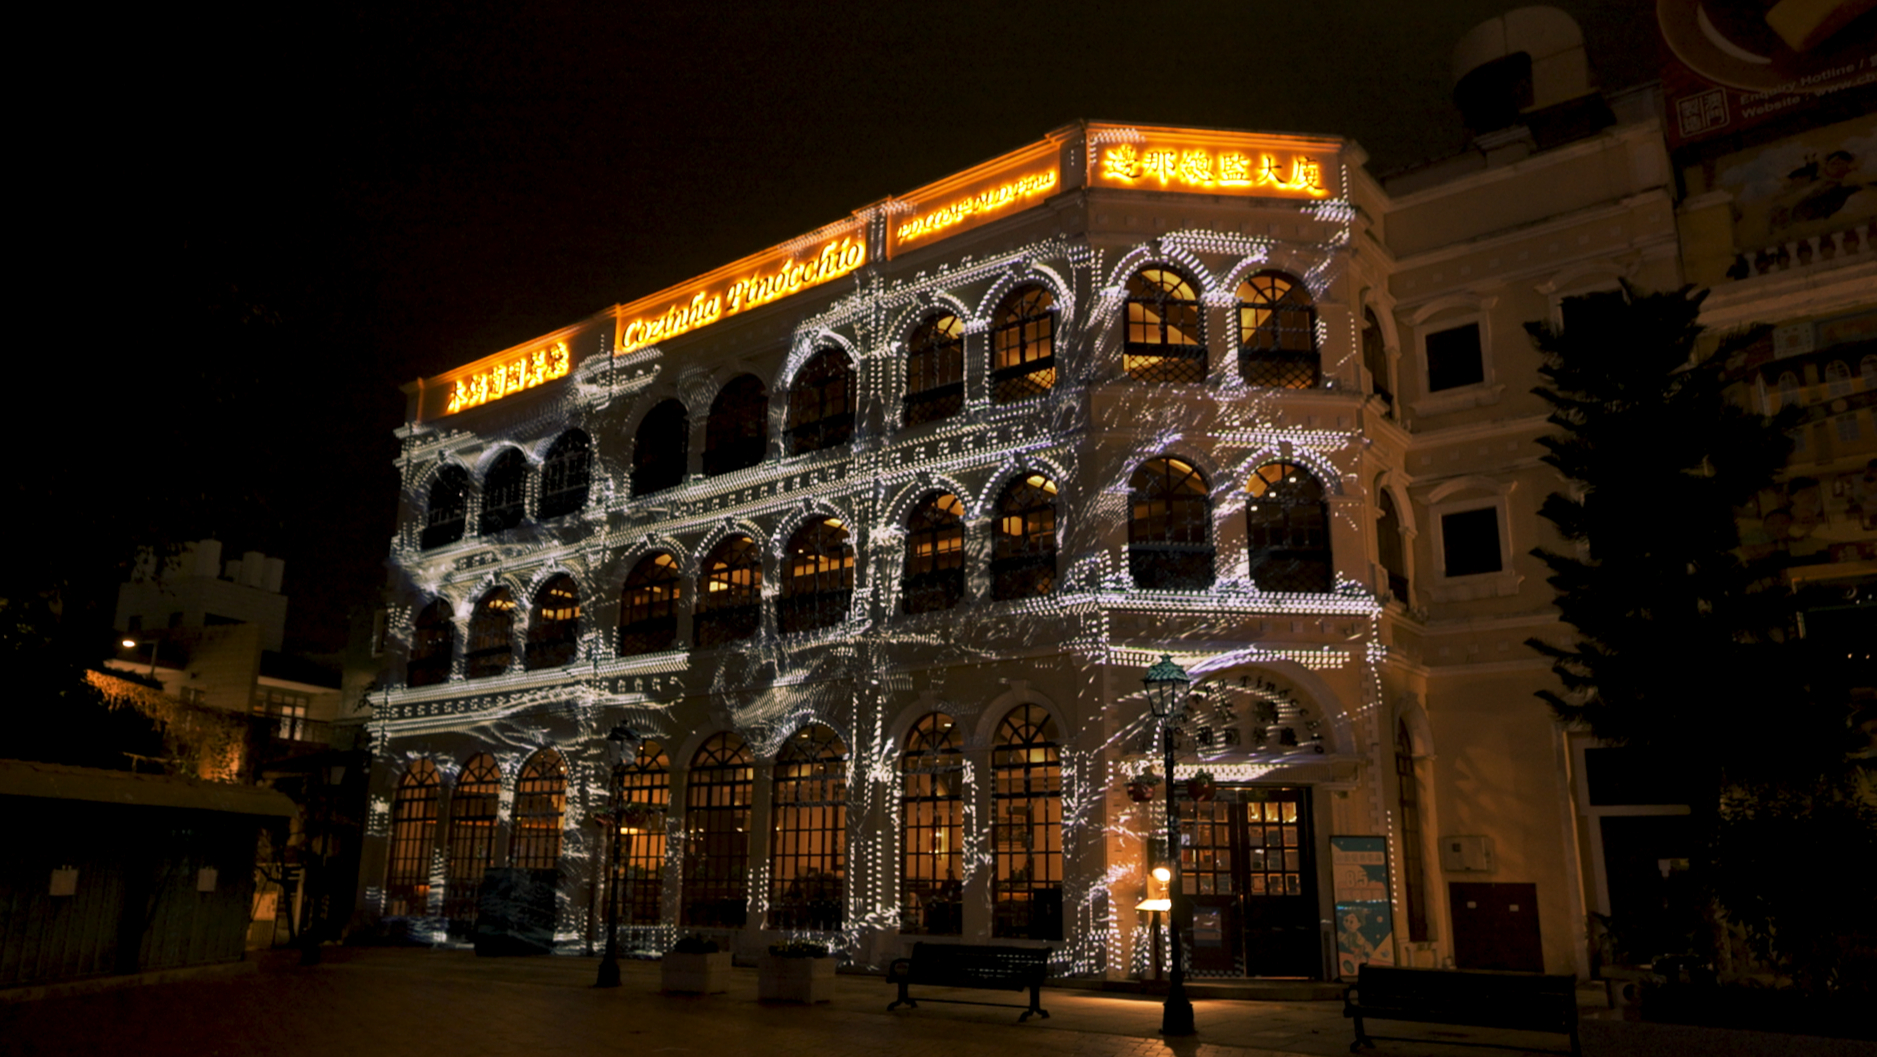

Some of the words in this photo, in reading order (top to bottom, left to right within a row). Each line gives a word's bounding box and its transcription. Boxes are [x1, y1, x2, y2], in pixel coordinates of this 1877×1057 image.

[1739, 81, 1797, 106] Enquiry
[1800, 63, 1855, 86] Hotline
[1741, 94, 1800, 120] Website
[623, 292, 720, 347] Cozinha
